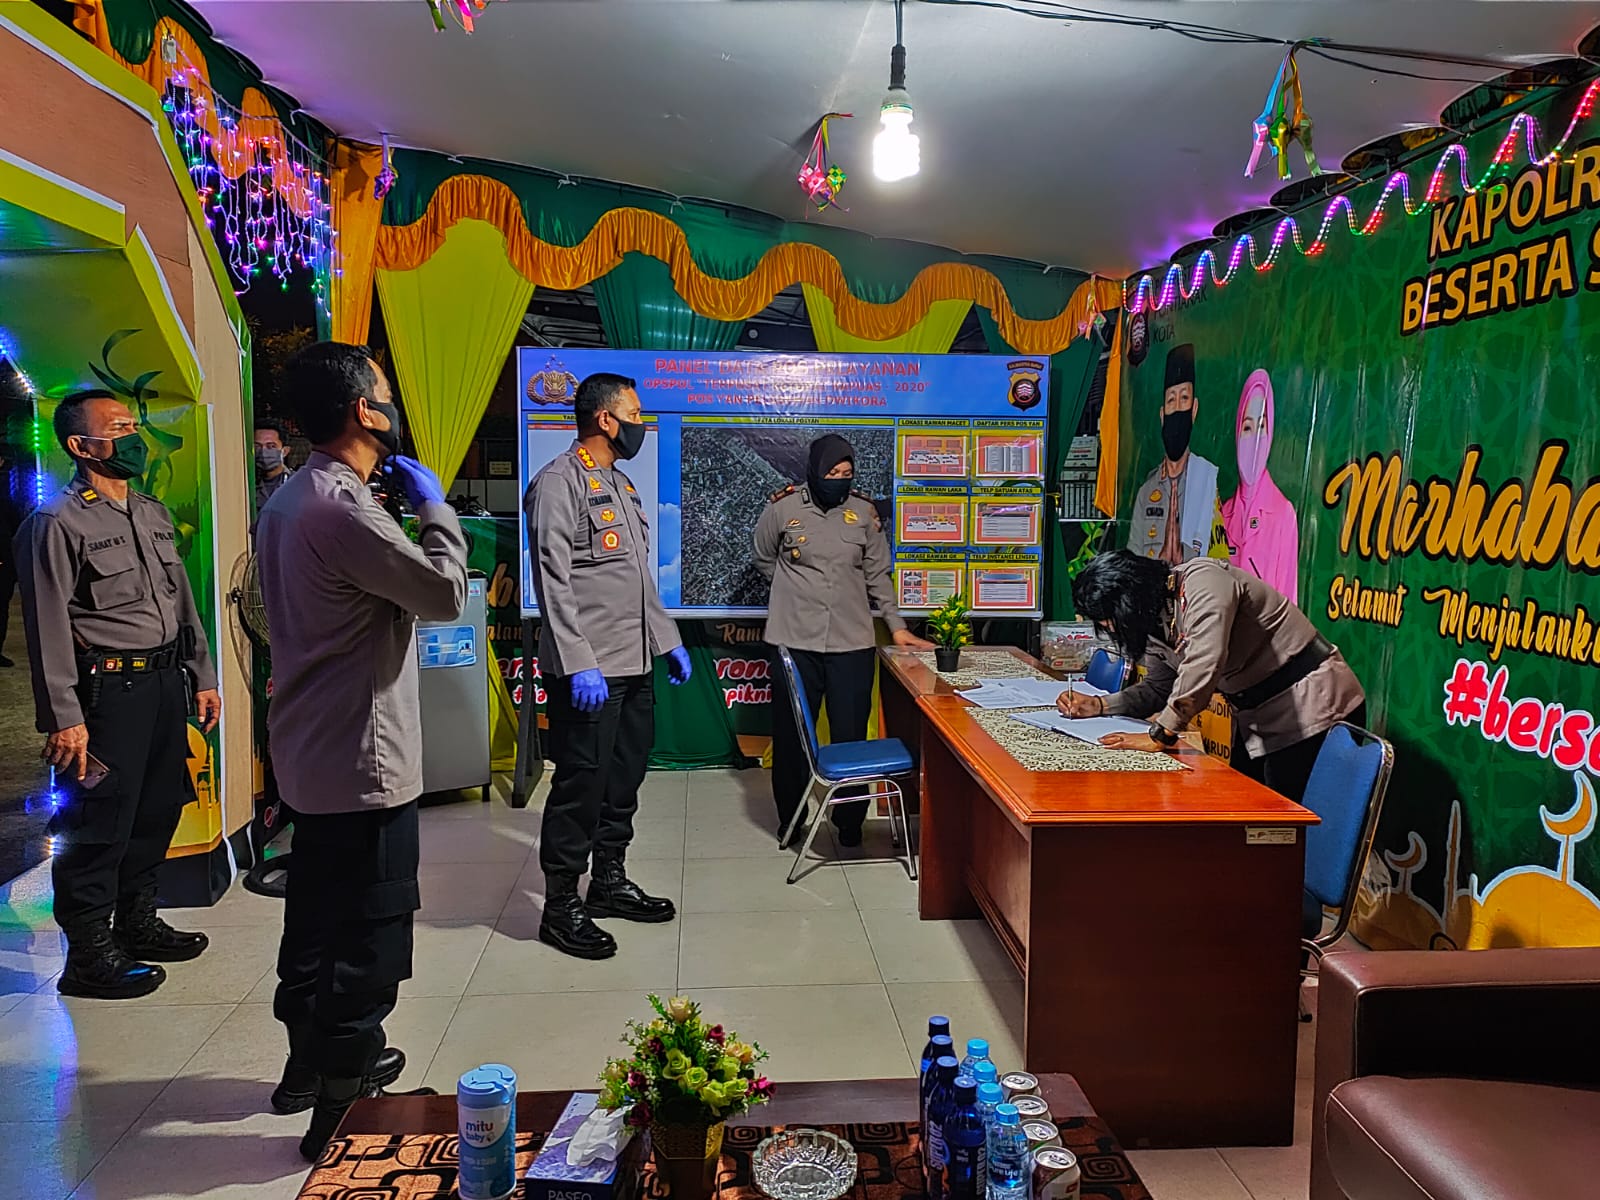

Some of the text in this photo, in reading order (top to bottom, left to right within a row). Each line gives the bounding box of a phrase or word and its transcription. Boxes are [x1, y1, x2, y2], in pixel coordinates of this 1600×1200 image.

[1401, 233, 1576, 333] BESERTA
[1153, 324, 1176, 344] KOTA
[655, 359, 712, 373] PANEL
[813, 361, 920, 377] PELAYANAN
[687, 394, 714, 405] POS
[1327, 575, 1600, 666] Selamat Menjalank
[1443, 657, 1600, 777] #bers
[465, 1120, 494, 1132] mitu
[465, 1132, 486, 1143] baby
